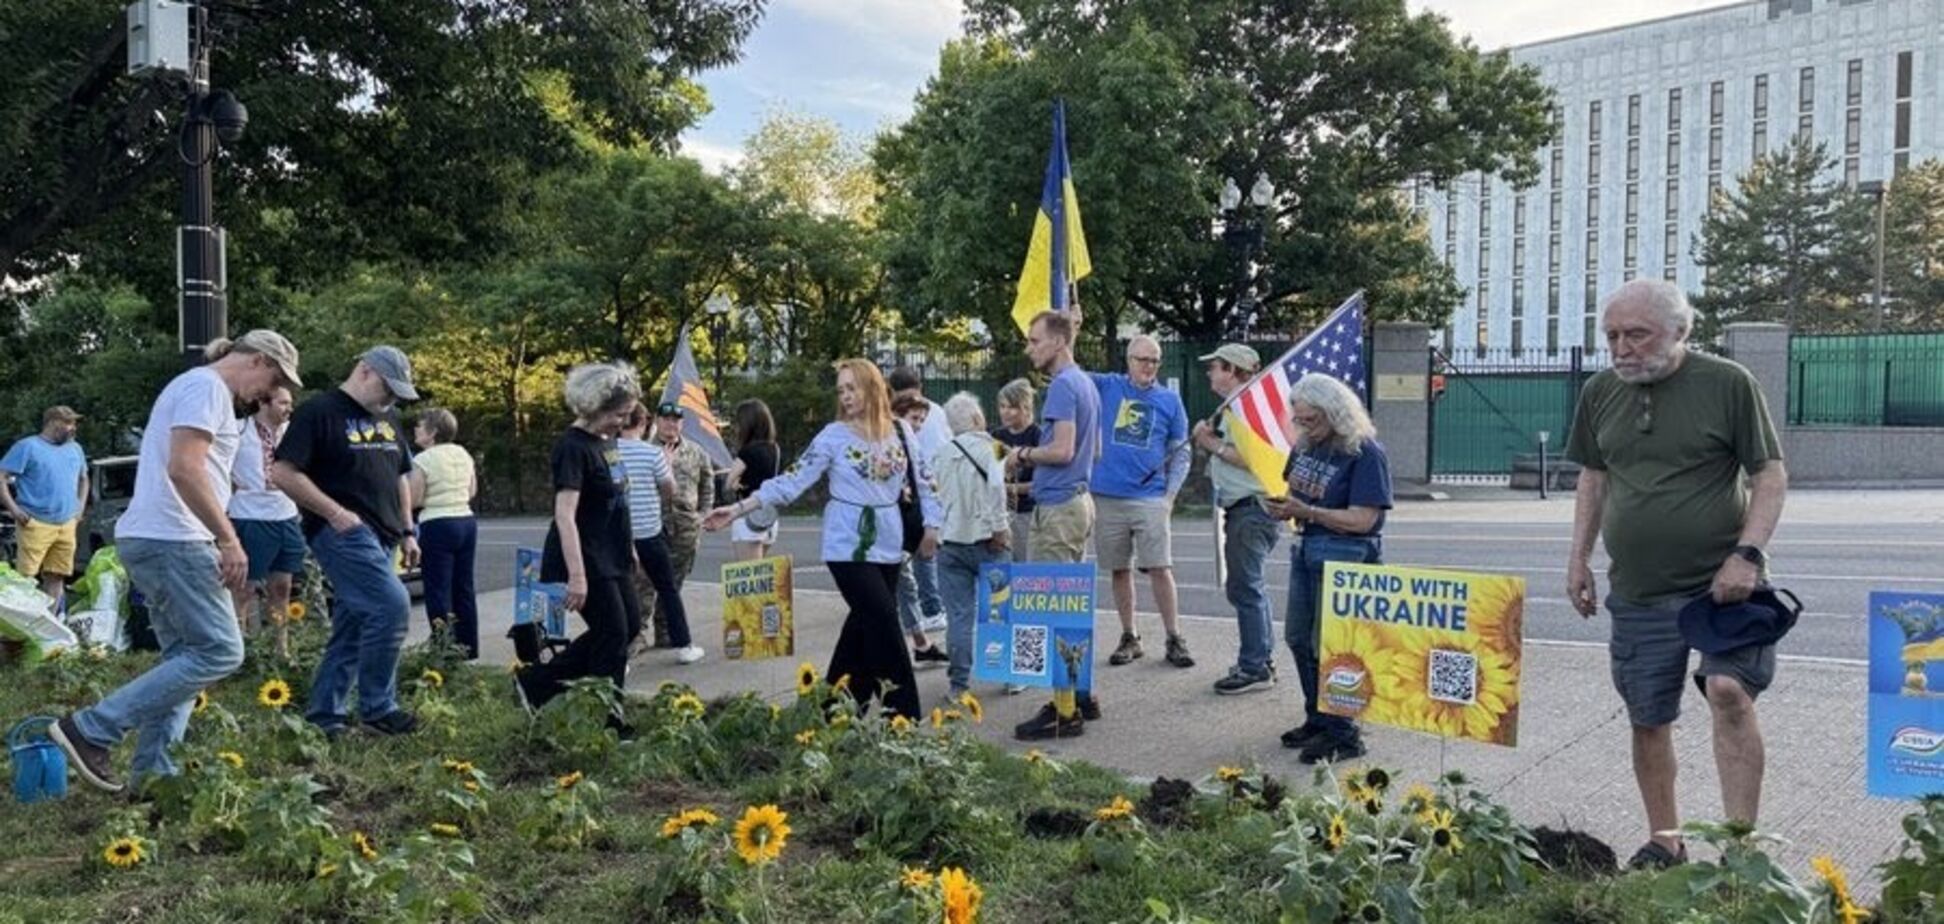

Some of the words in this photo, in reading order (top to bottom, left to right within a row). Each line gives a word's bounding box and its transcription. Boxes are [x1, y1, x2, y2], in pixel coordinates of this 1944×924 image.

[725, 577, 774, 598] UKRAINE
[1333, 570, 1403, 593] STAND
[1410, 578, 1468, 600] WITH
[1012, 592, 1090, 612] UKRAINE
[1332, 591, 1467, 631] UKRAINE
